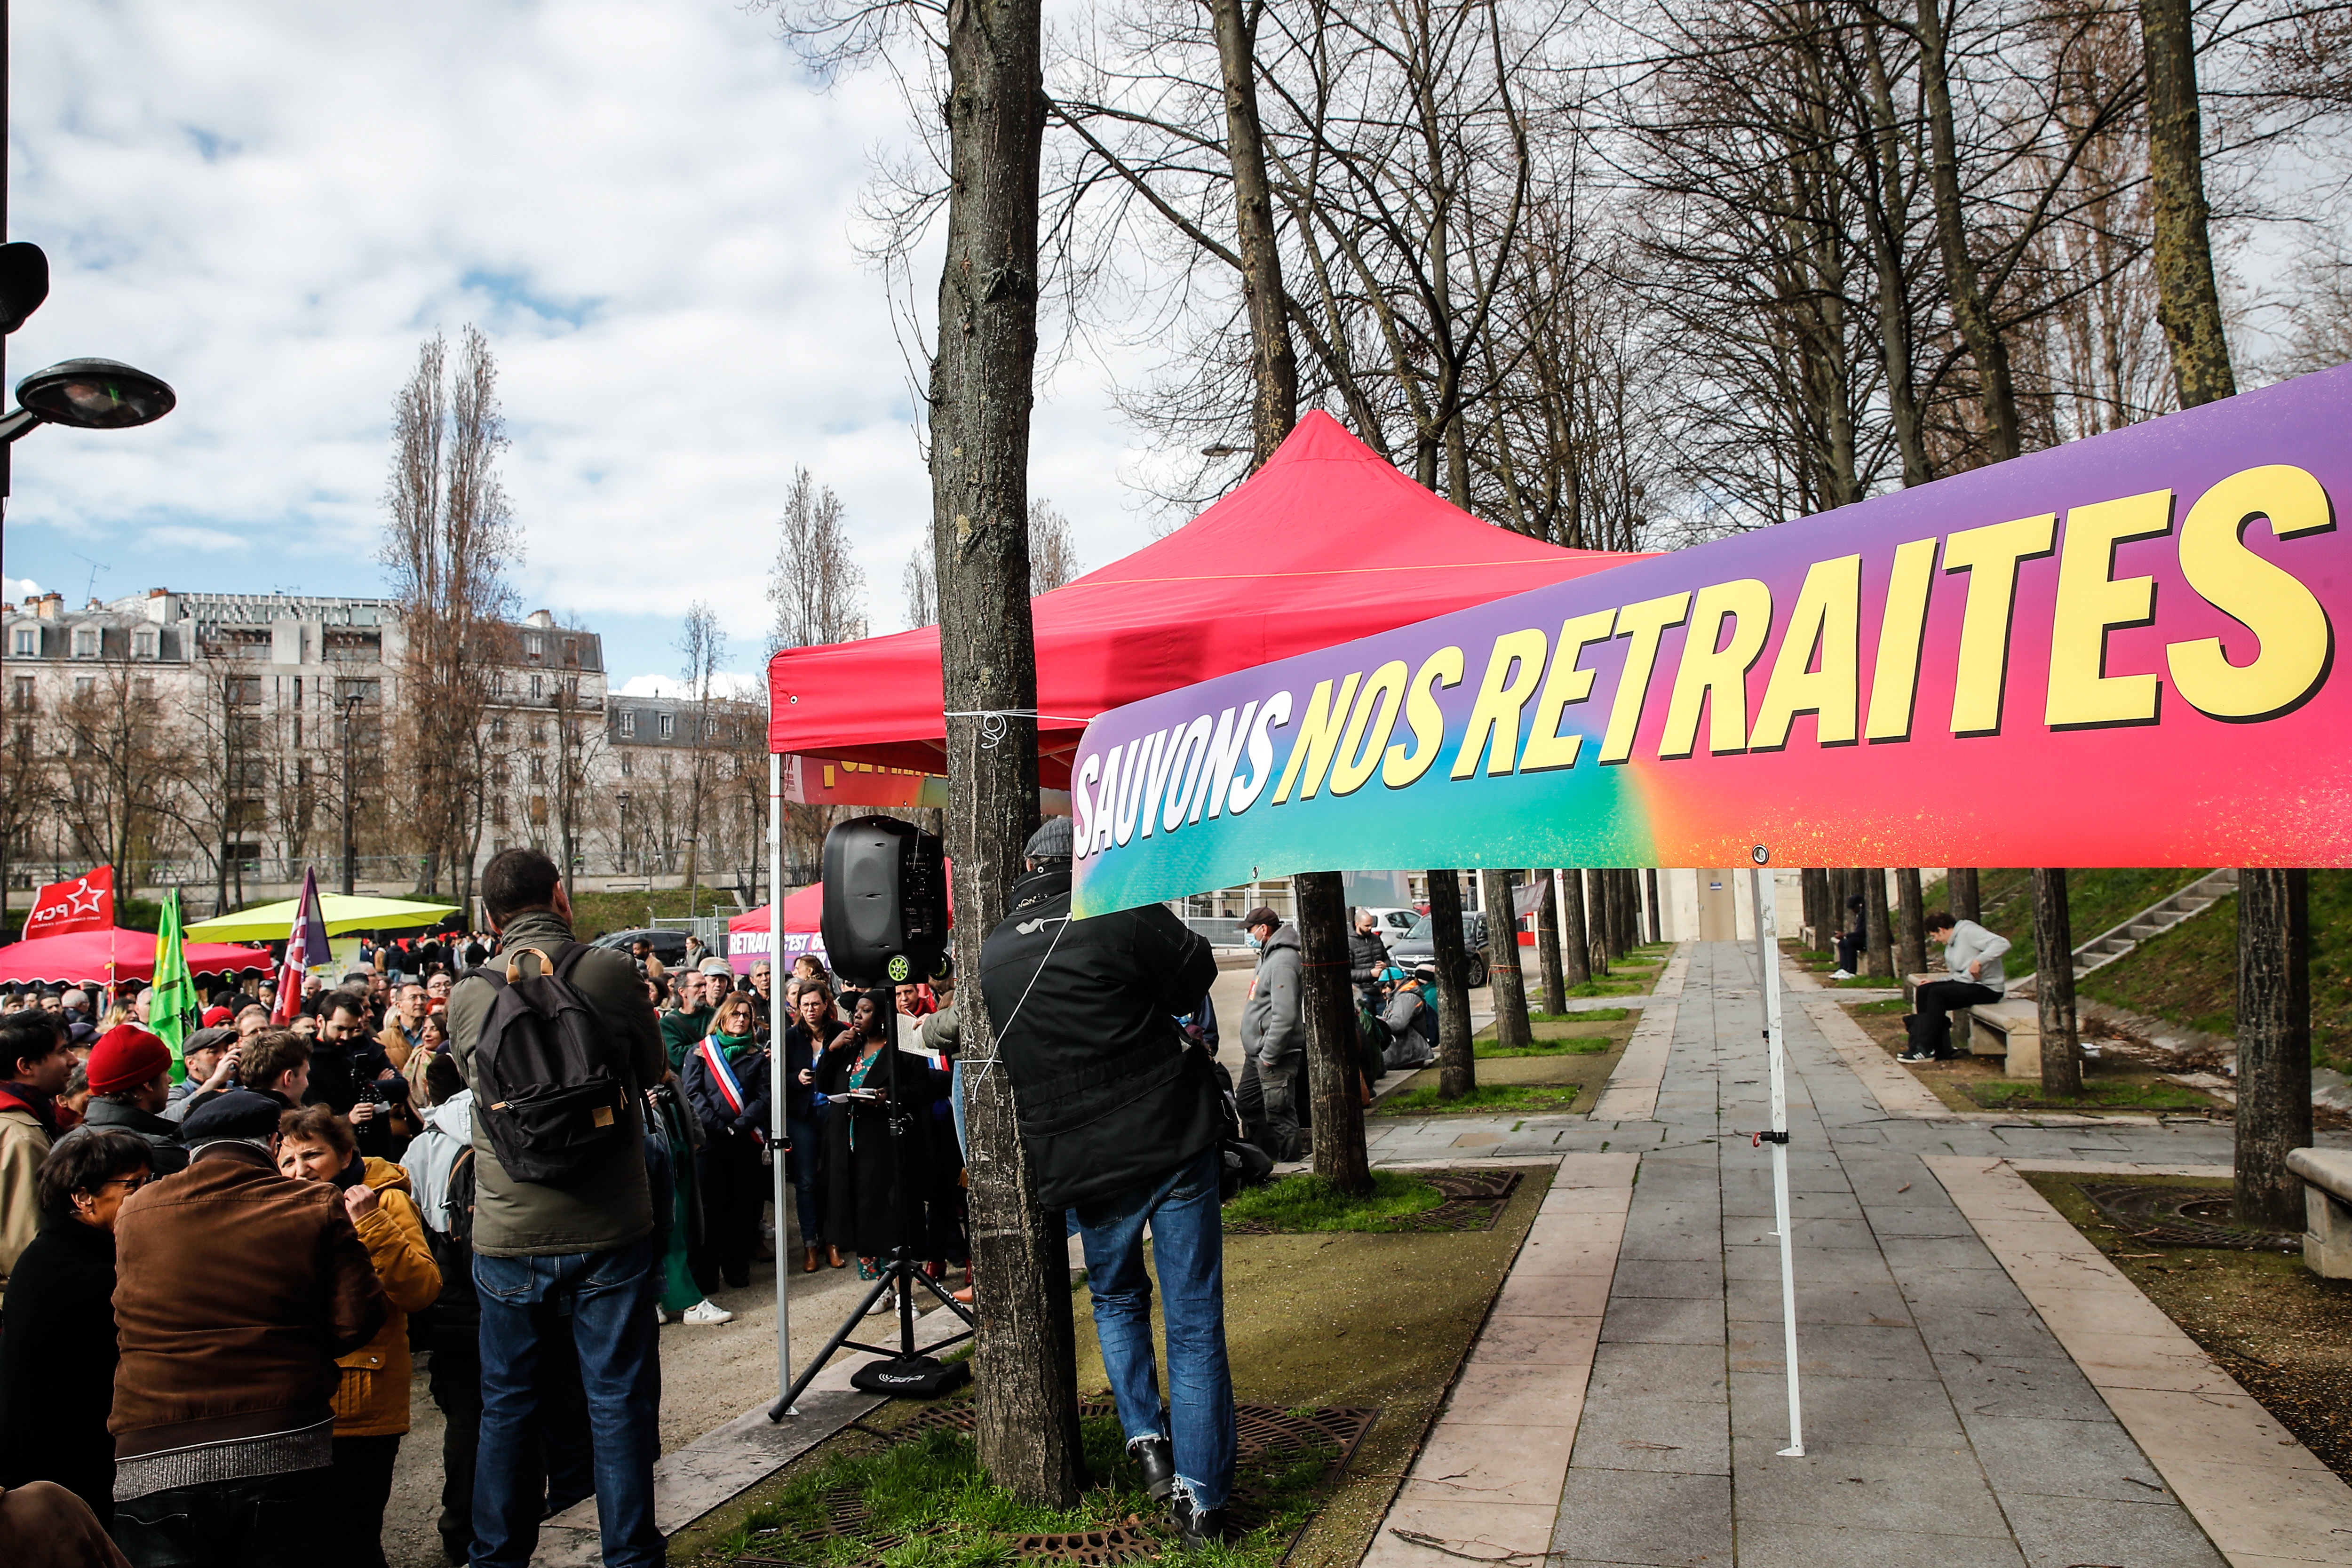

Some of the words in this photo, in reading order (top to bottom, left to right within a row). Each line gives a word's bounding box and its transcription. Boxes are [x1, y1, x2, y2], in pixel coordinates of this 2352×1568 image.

[1073, 690, 1293, 860] SAUVONS
[1271, 646, 1465, 804] NOS
[1450, 463, 2336, 781] RETRAITES
[730, 932, 771, 955] RETRAIT
